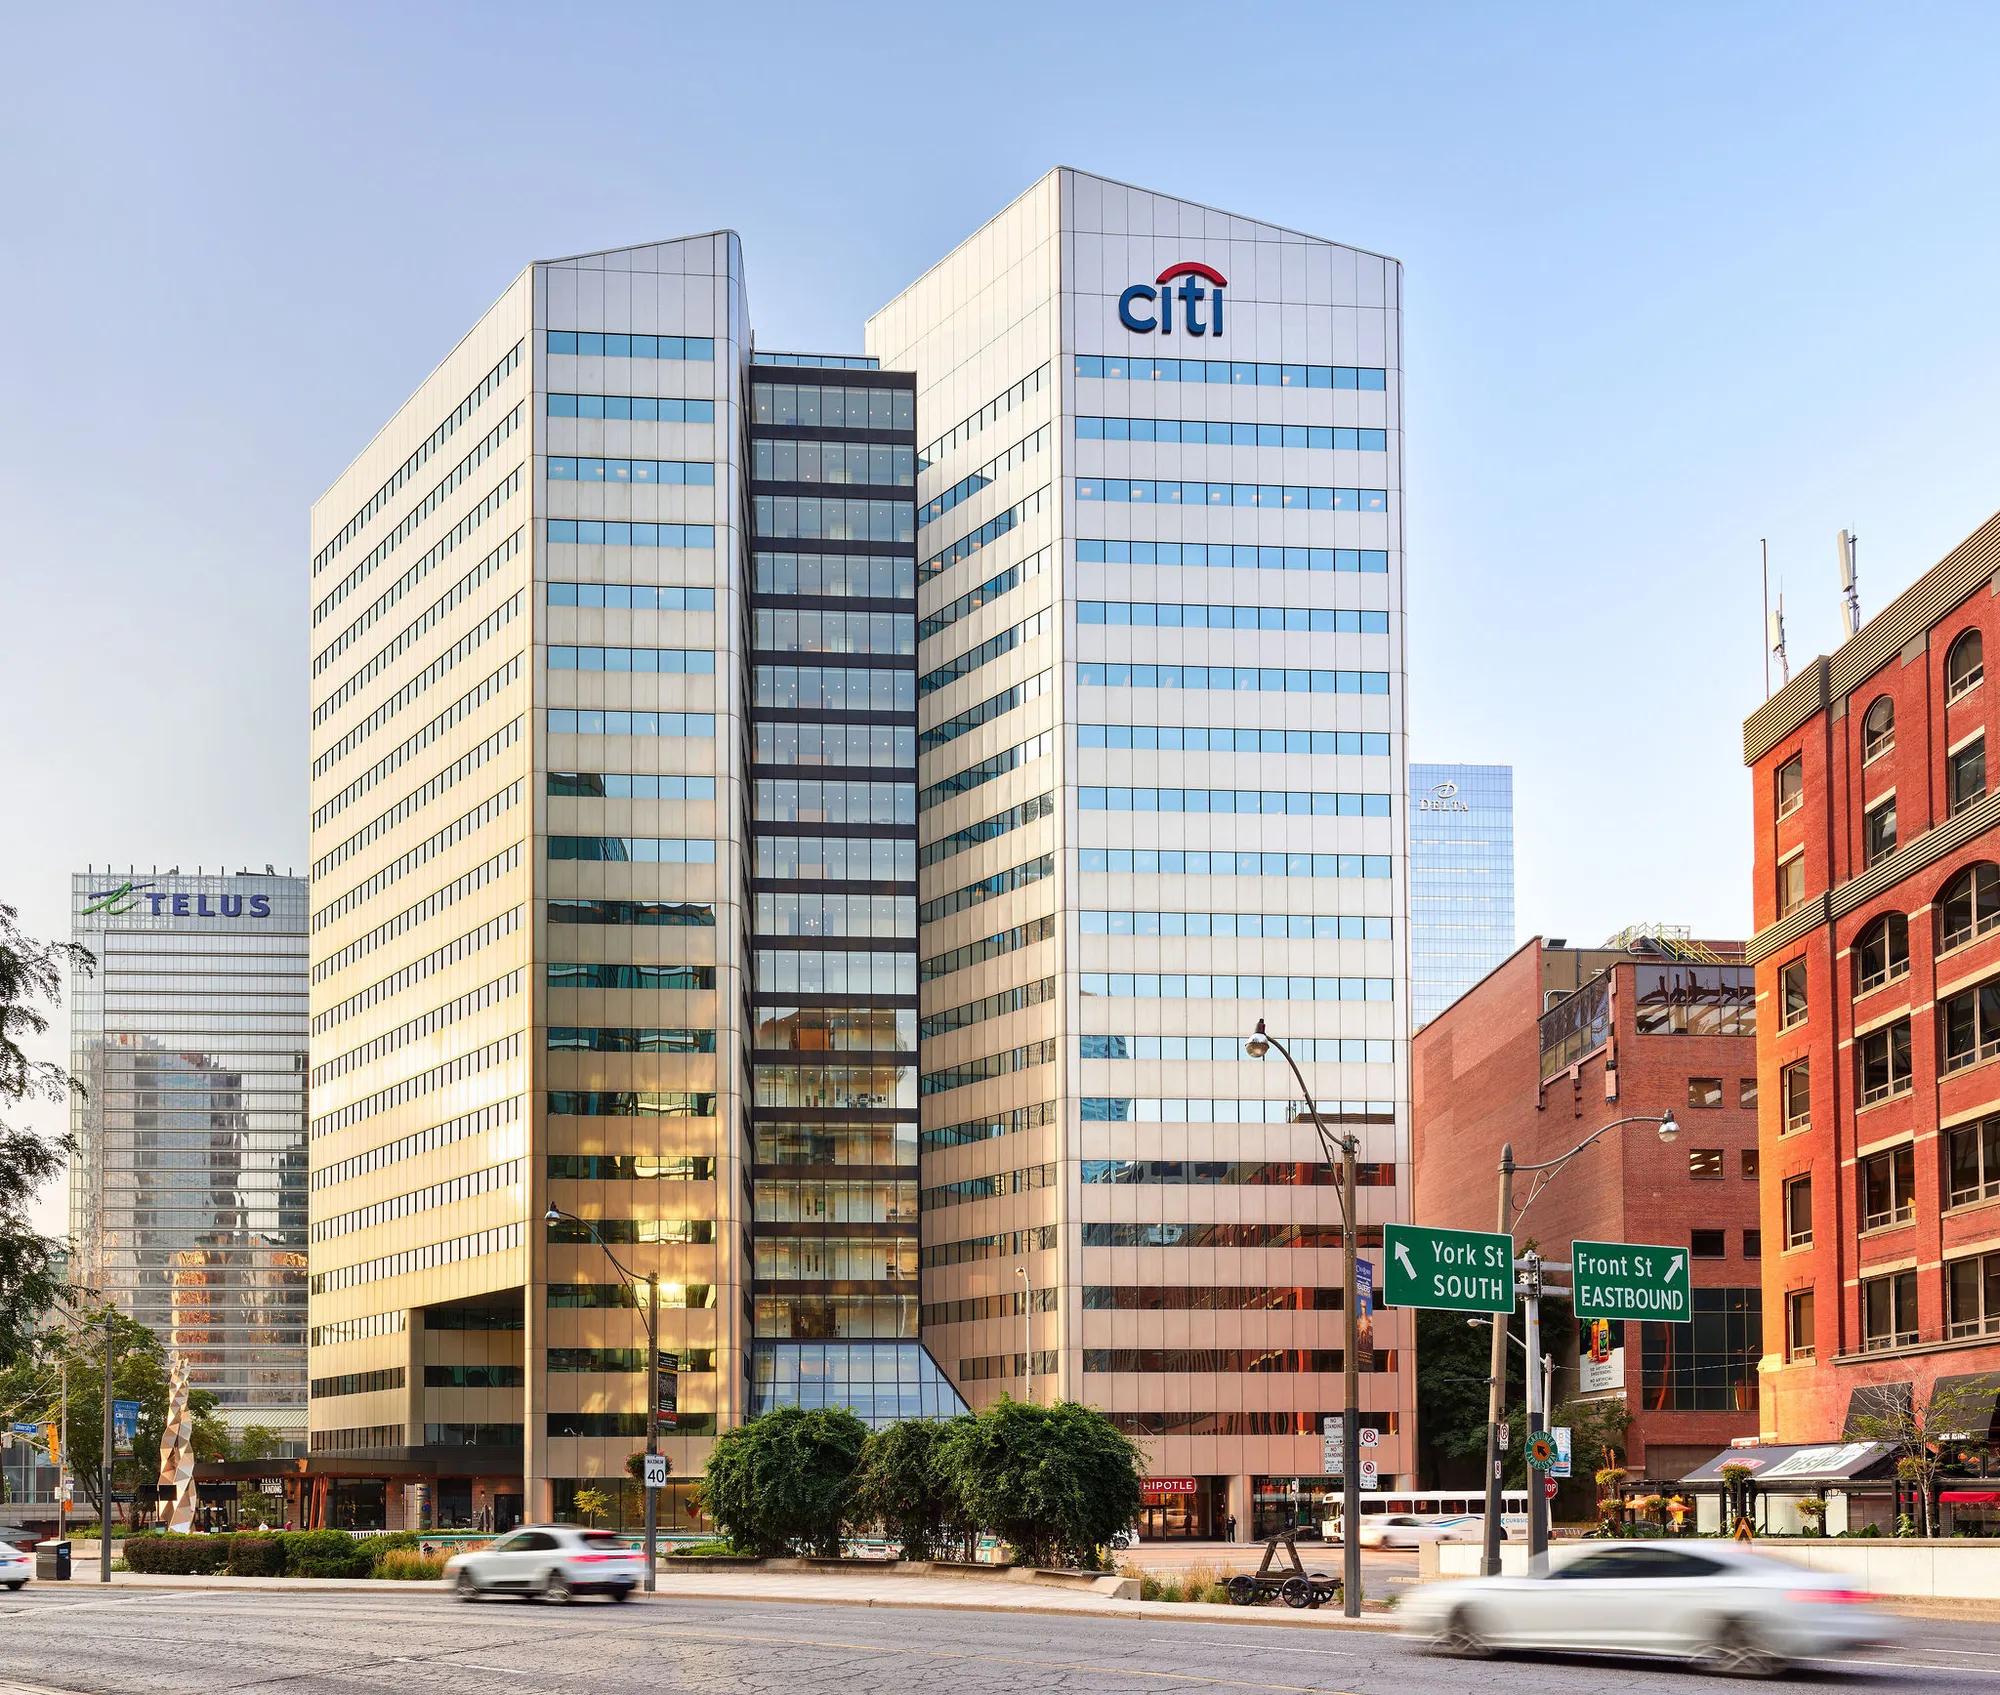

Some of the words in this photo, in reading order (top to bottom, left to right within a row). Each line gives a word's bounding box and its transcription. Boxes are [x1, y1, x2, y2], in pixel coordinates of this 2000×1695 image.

[1119, 272, 1224, 337] citi
[1419, 799, 1469, 812] DELTA
[145, 892, 271, 918] TELUS
[1431, 1240, 1477, 1266] York
[1484, 1245, 1504, 1268] St
[1578, 1252, 1628, 1276] Front
[1634, 1256, 1653, 1278] St
[1433, 1274, 1503, 1300] SOUTH
[1581, 1285, 1683, 1311] EASTBOUND
[647, 1469, 664, 1483] 40
[1143, 1481, 1193, 1489] HIPOTLE
[1545, 1483, 1557, 1492] TOP
[261, 1485, 283, 1494] LANDING
